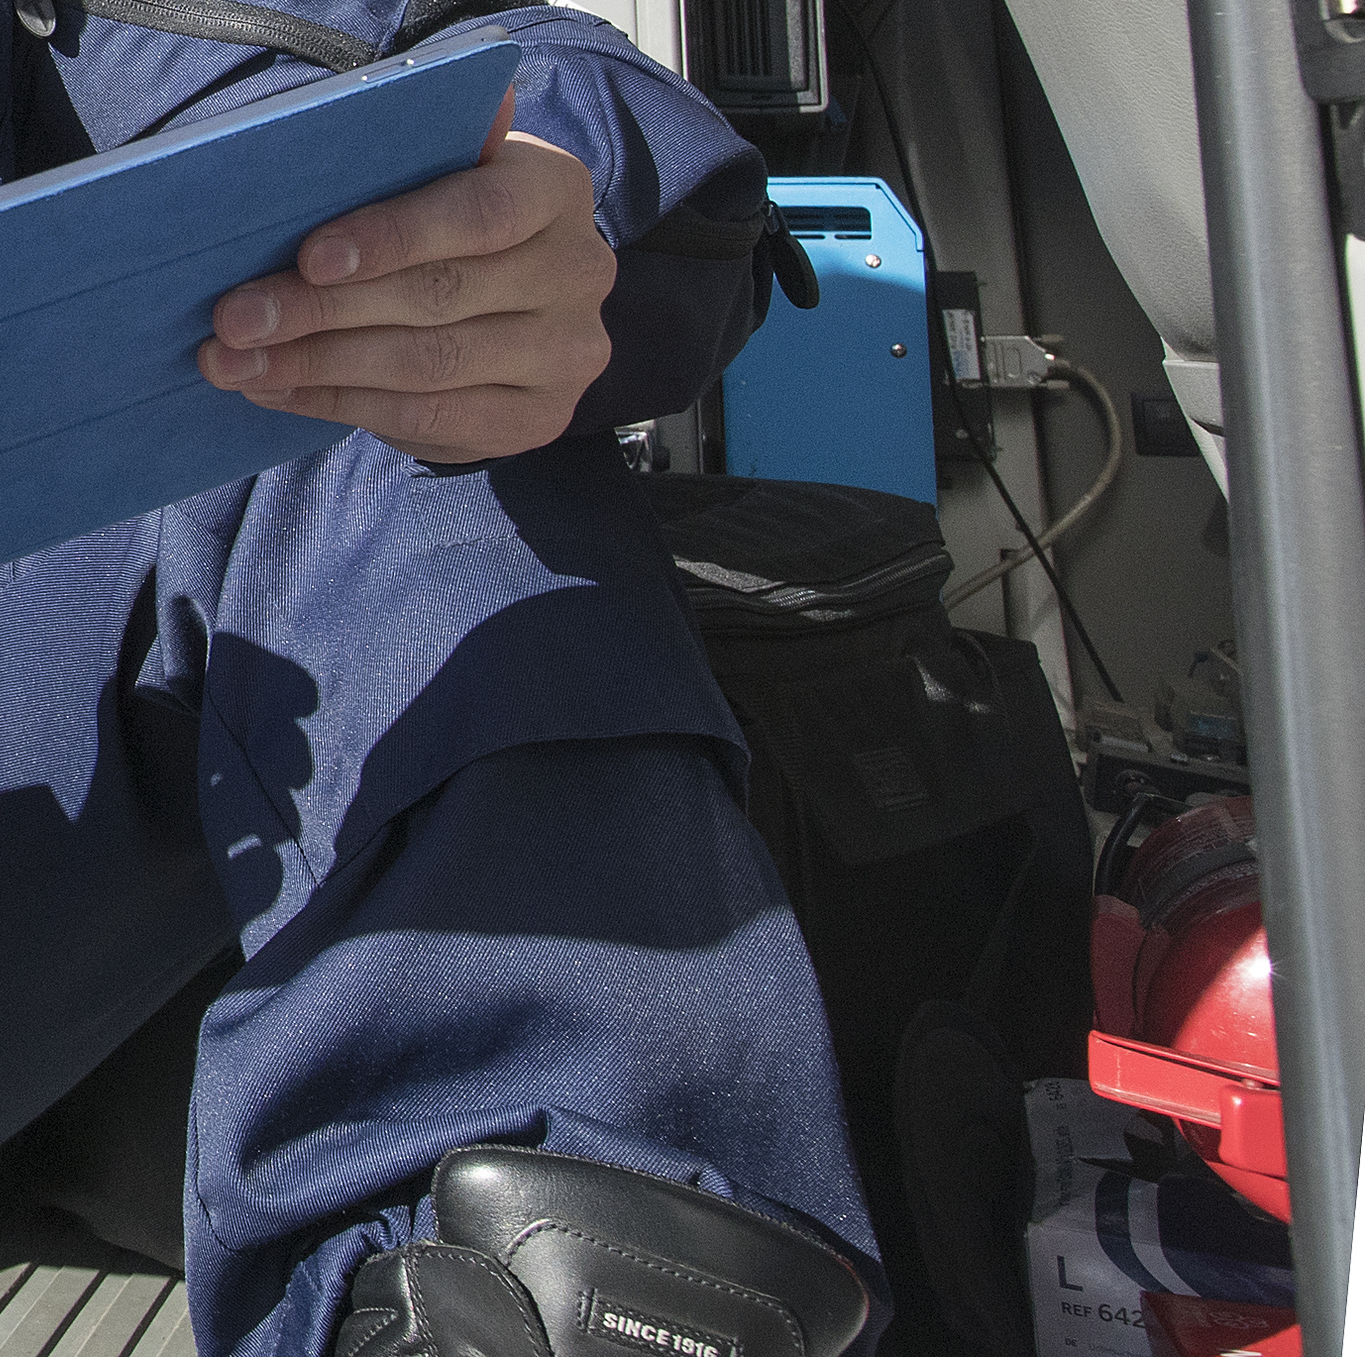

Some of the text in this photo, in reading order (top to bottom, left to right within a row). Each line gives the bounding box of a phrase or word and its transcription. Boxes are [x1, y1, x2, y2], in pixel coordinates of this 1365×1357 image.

[1057, 1255, 1083, 1292] L
[1061, 1301, 1092, 1318] REF
[602, 1312, 672, 1346] SINCE
